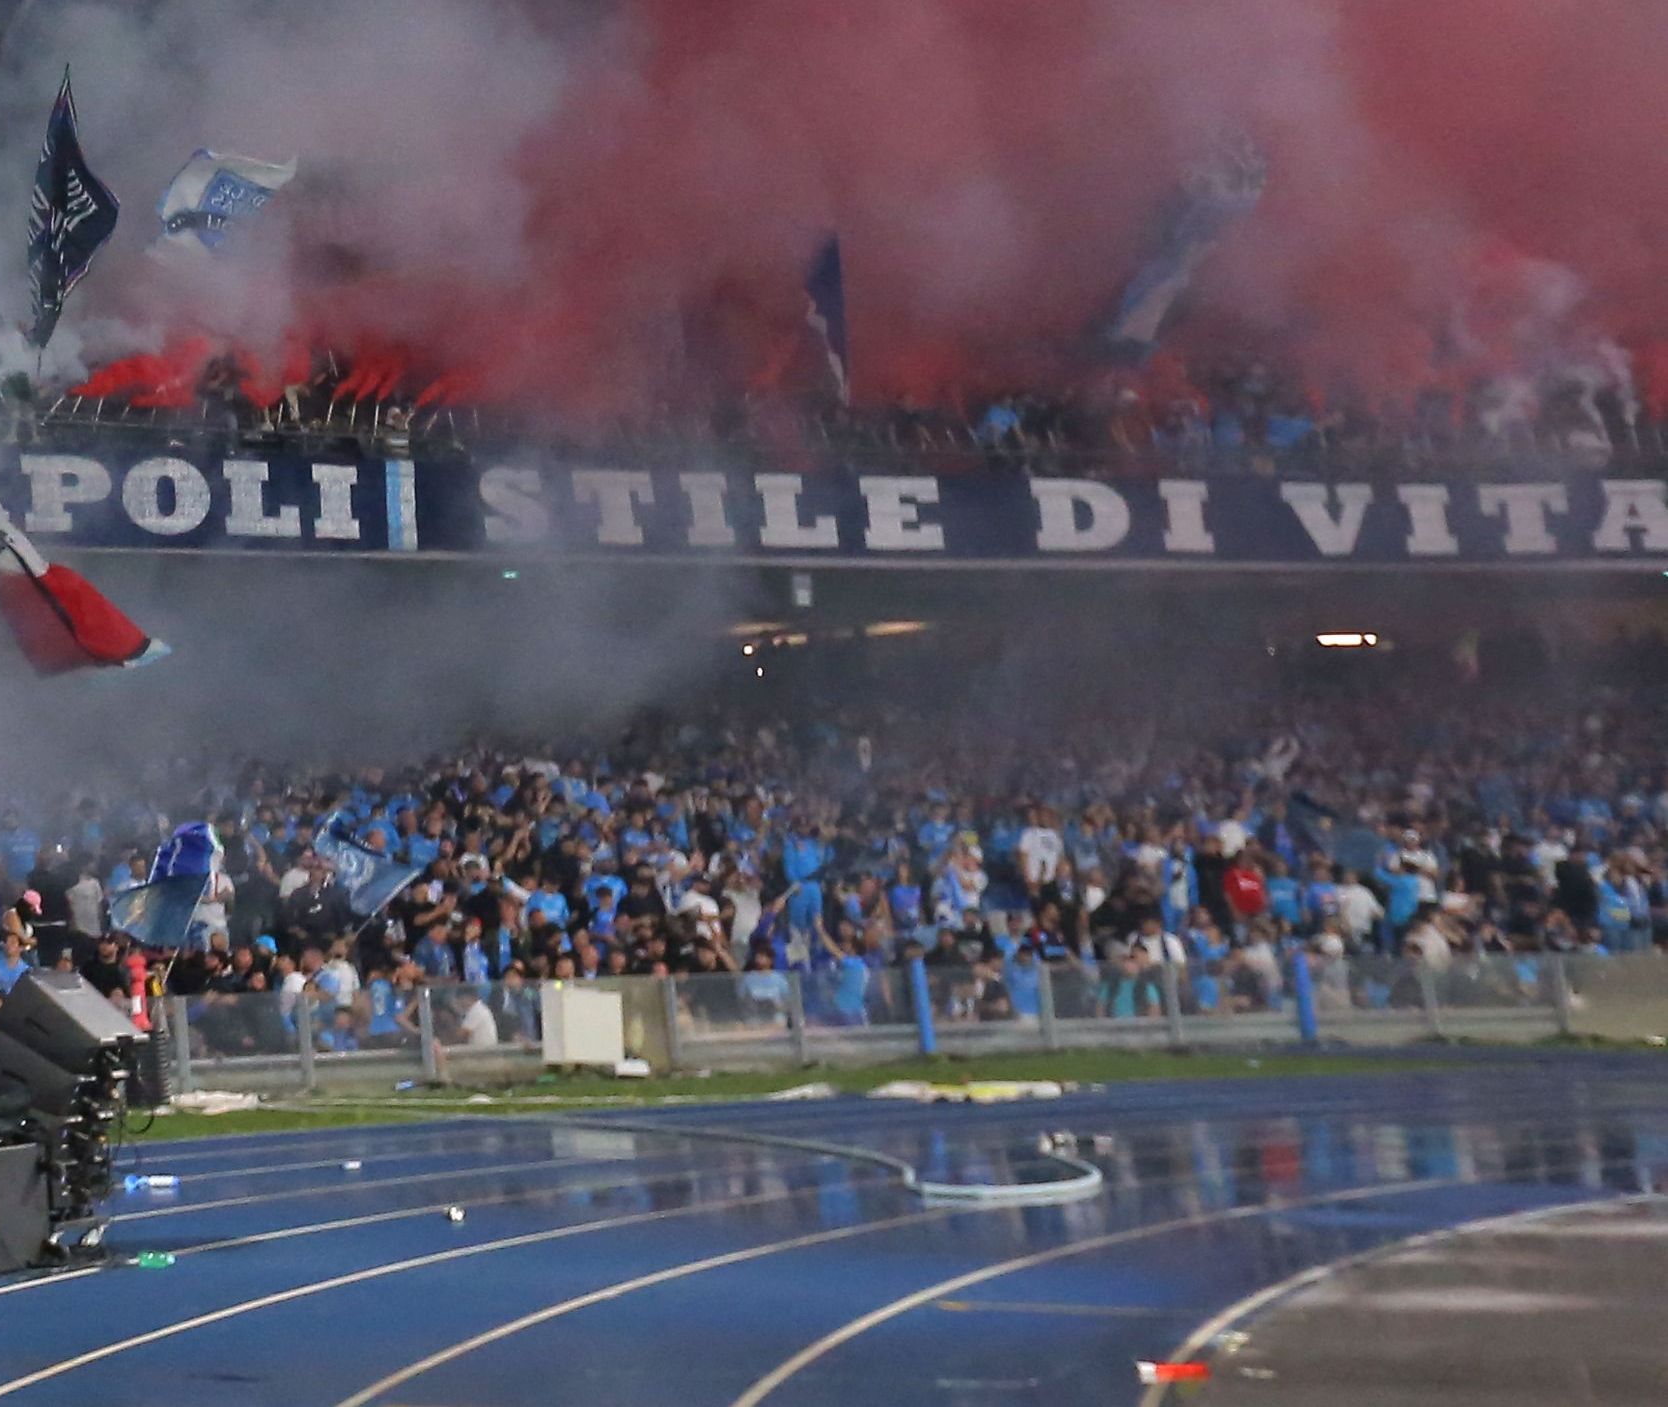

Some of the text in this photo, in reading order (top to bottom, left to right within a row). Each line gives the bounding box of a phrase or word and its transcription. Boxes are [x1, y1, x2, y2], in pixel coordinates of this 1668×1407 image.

[478, 469, 946, 550] STILE
[1028, 476, 1216, 555] DI
[1280, 478, 1668, 556] VITA
